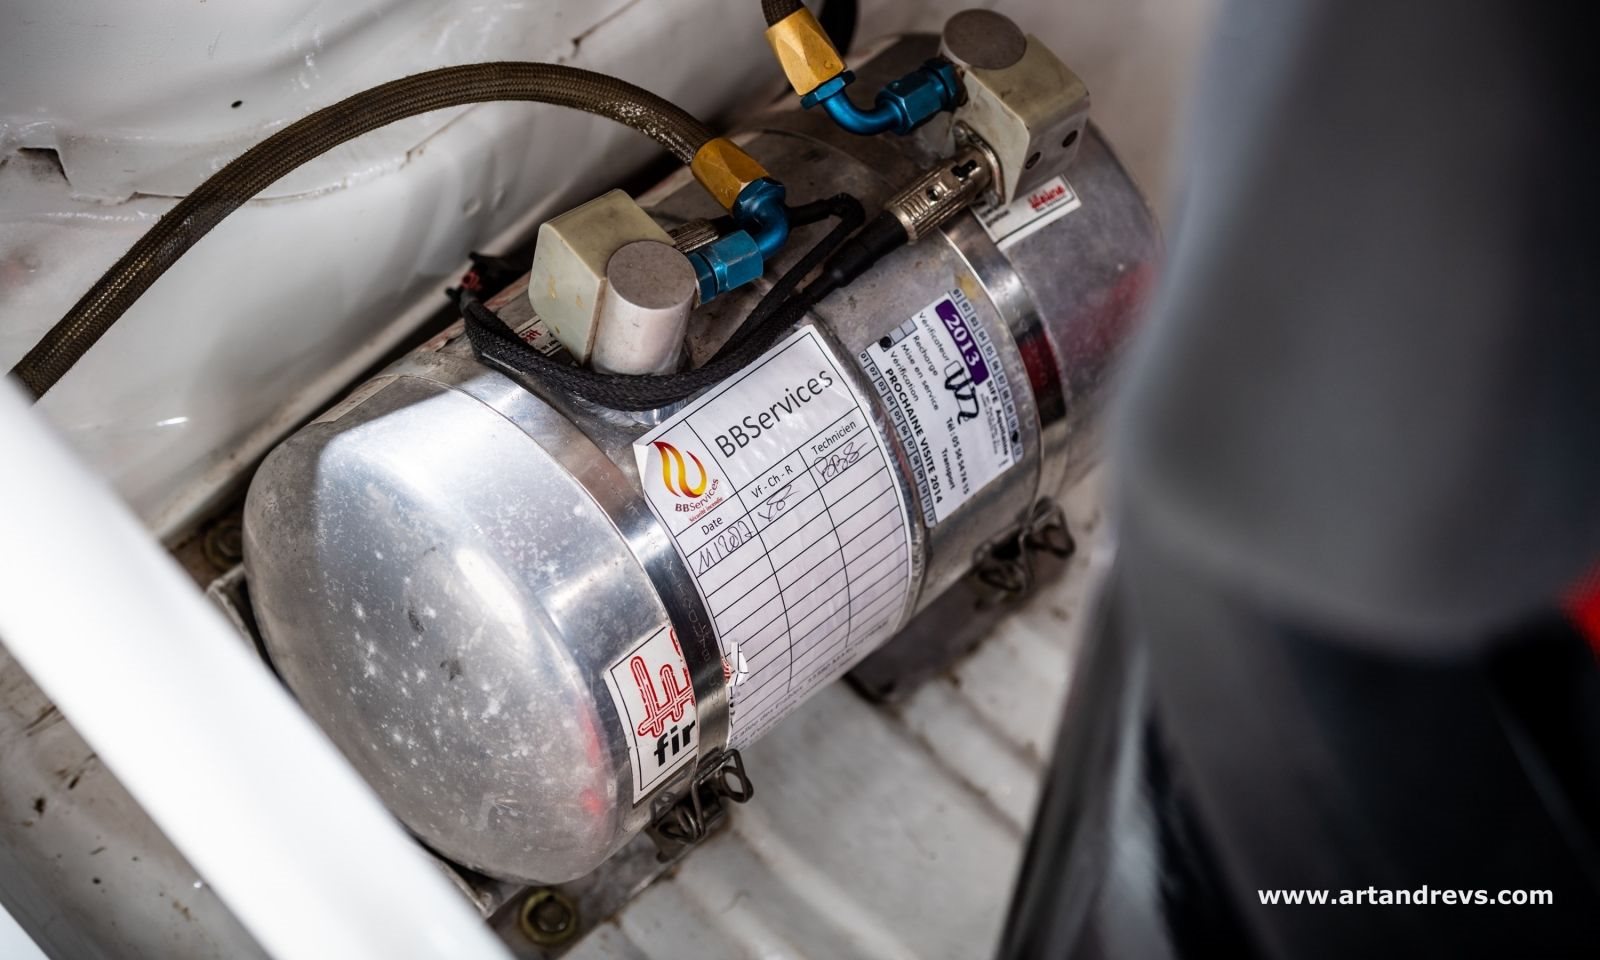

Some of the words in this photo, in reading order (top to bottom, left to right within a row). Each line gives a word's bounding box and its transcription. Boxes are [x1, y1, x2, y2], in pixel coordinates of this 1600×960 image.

[953, 288, 962, 298] 01
[979, 331, 987, 341] 04
[913, 335, 938, 376] Recharge
[944, 314, 980, 366] 2013
[901, 343, 915, 365] Mise
[914, 367, 923, 379] en
[921, 380, 939, 411] service
[714, 369, 834, 458] BBServices
[860, 353, 869, 362] 01
[869, 367, 878, 377] 02
[878, 381, 887, 391] 03
[886, 396, 895, 406] 04
[894, 410, 902, 421] 05
[901, 425, 909, 436] 06
[907, 441, 915, 450] 07
[811, 421, 857, 455] Technicien
[885, 368, 924, 437] PROCHAINE
[920, 437, 936, 474] VISITE
[930, 475, 943, 504] 2014
[751, 484, 763, 498] Vf
[768, 474, 781, 487] Ch
[784, 465, 794, 476] R
[941, 448, 956, 490] Transport
[675, 478, 719, 512] BBServices
[701, 517, 724, 536] Date
[654, 720, 697, 767] fir
